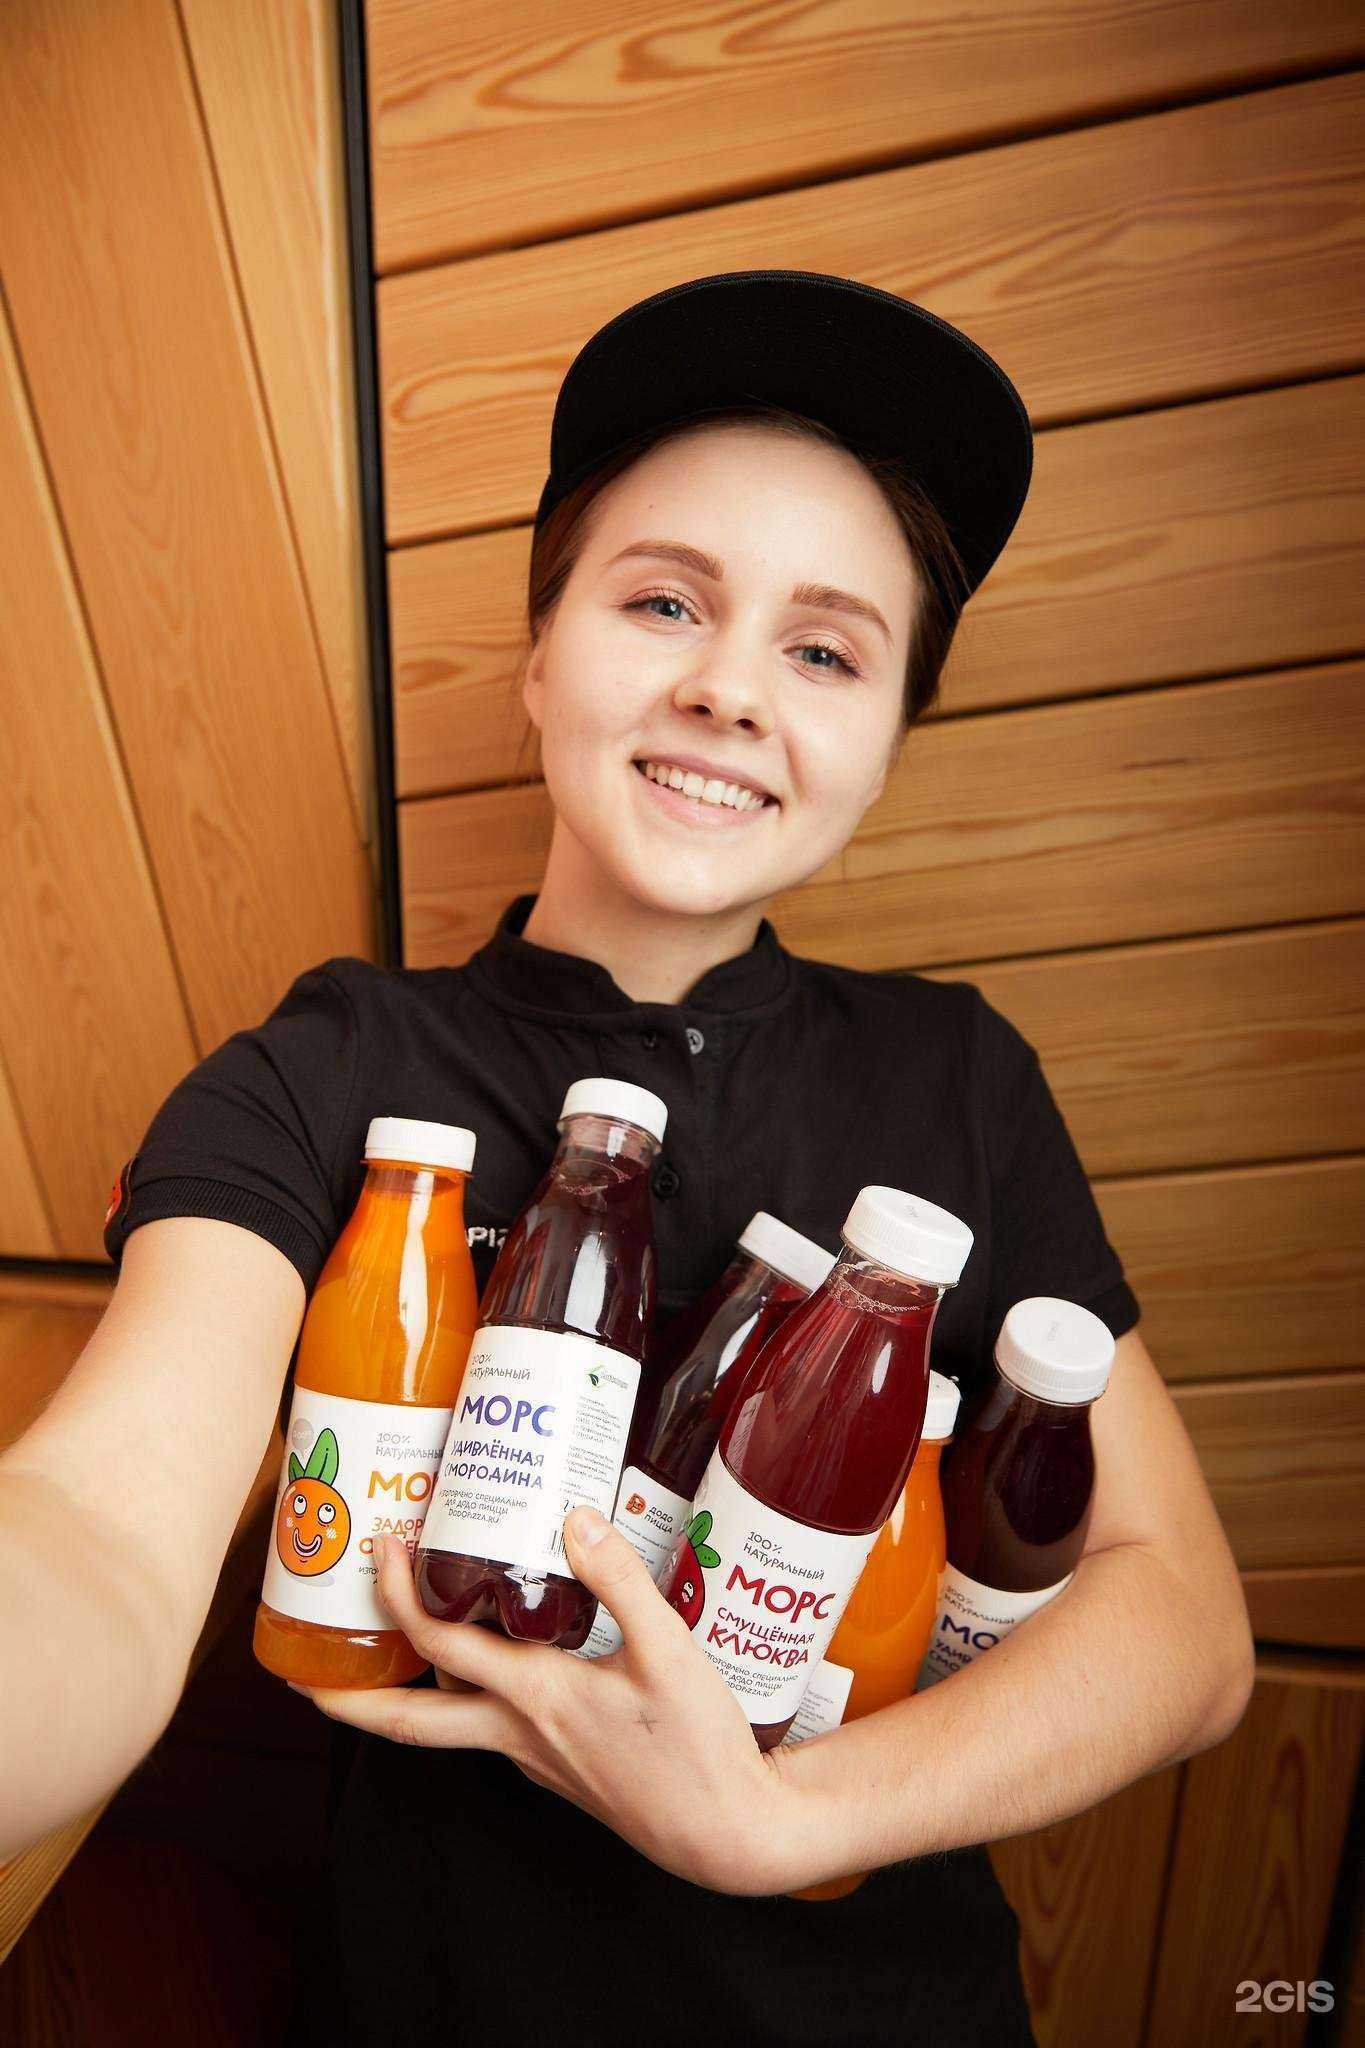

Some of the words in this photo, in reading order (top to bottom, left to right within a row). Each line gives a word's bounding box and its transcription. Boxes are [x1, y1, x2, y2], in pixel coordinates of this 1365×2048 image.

[460, 1395, 556, 1437] МОРС
[376, 1446, 443, 1461] НАТУРАЛЬНЫ
[377, 1433, 410, 1444] 100%
[451, 1438, 545, 1467] УДИВЛЁННАЯ
[444, 1462, 543, 1489] СМОРОДИНА
[371, 1517, 423, 1538] ЗАДОР
[747, 1532, 783, 1554] 100%
[743, 1543, 824, 1580] НАТУРАЛЬНЫЙ
[725, 1564, 836, 1624] МОРС
[717, 1607, 815, 1645] СМУЩЁННАЯ
[941, 1614, 1000, 1650] МО
[707, 1623, 808, 1668] КЛЮКВА
